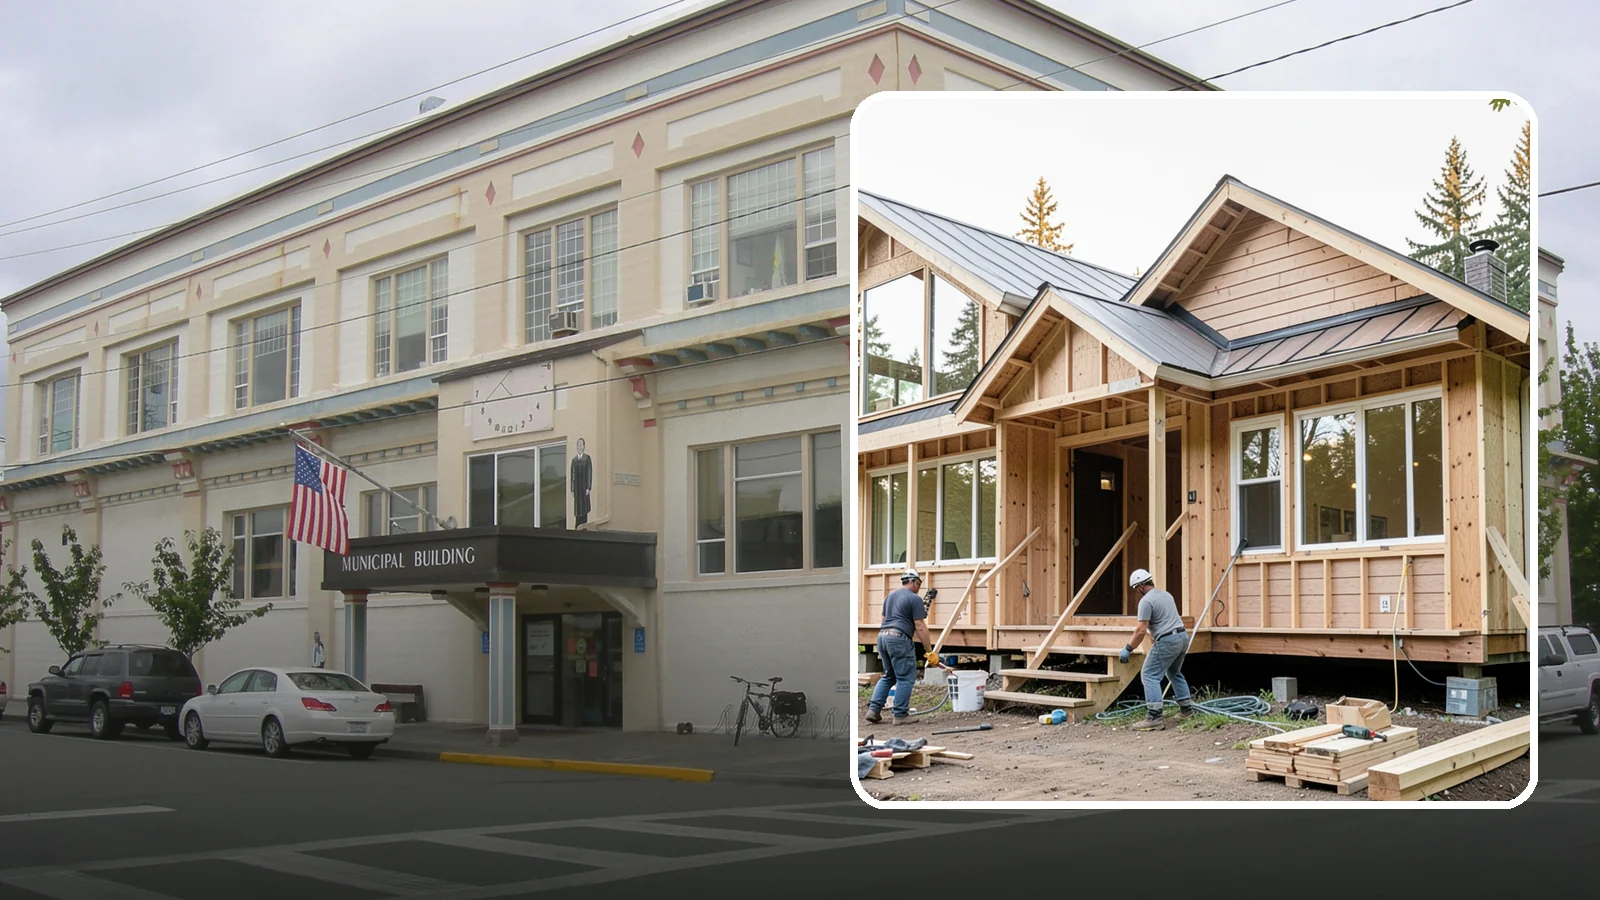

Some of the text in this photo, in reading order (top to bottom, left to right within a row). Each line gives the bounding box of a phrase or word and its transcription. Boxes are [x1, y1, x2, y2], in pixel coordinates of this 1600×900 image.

[529, 414, 533, 422] 3
[342, 546, 475, 572] MUNICIPAL BUILDING
